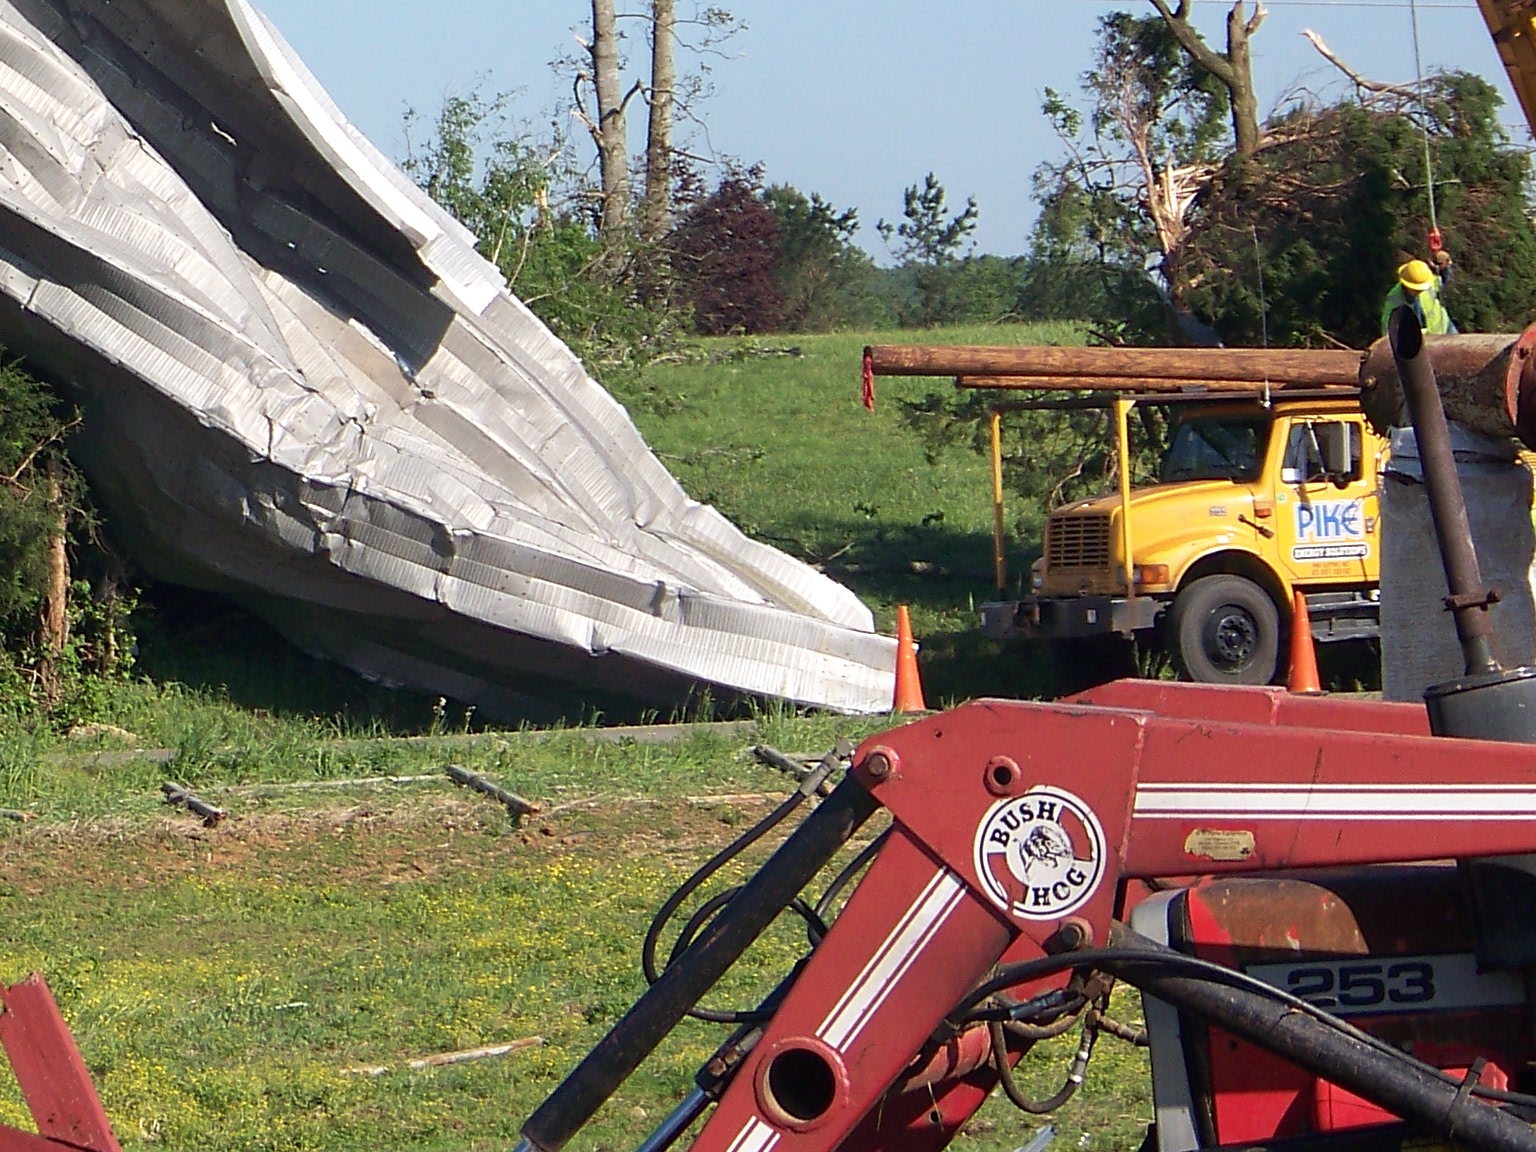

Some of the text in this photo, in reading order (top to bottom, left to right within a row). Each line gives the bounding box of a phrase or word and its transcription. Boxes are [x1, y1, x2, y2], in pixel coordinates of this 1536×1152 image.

[1297, 502, 1360, 538] PIKE
[989, 799, 1057, 848] BUSH
[1031, 866, 1087, 906] HOG
[1287, 961, 1436, 1008] 253
